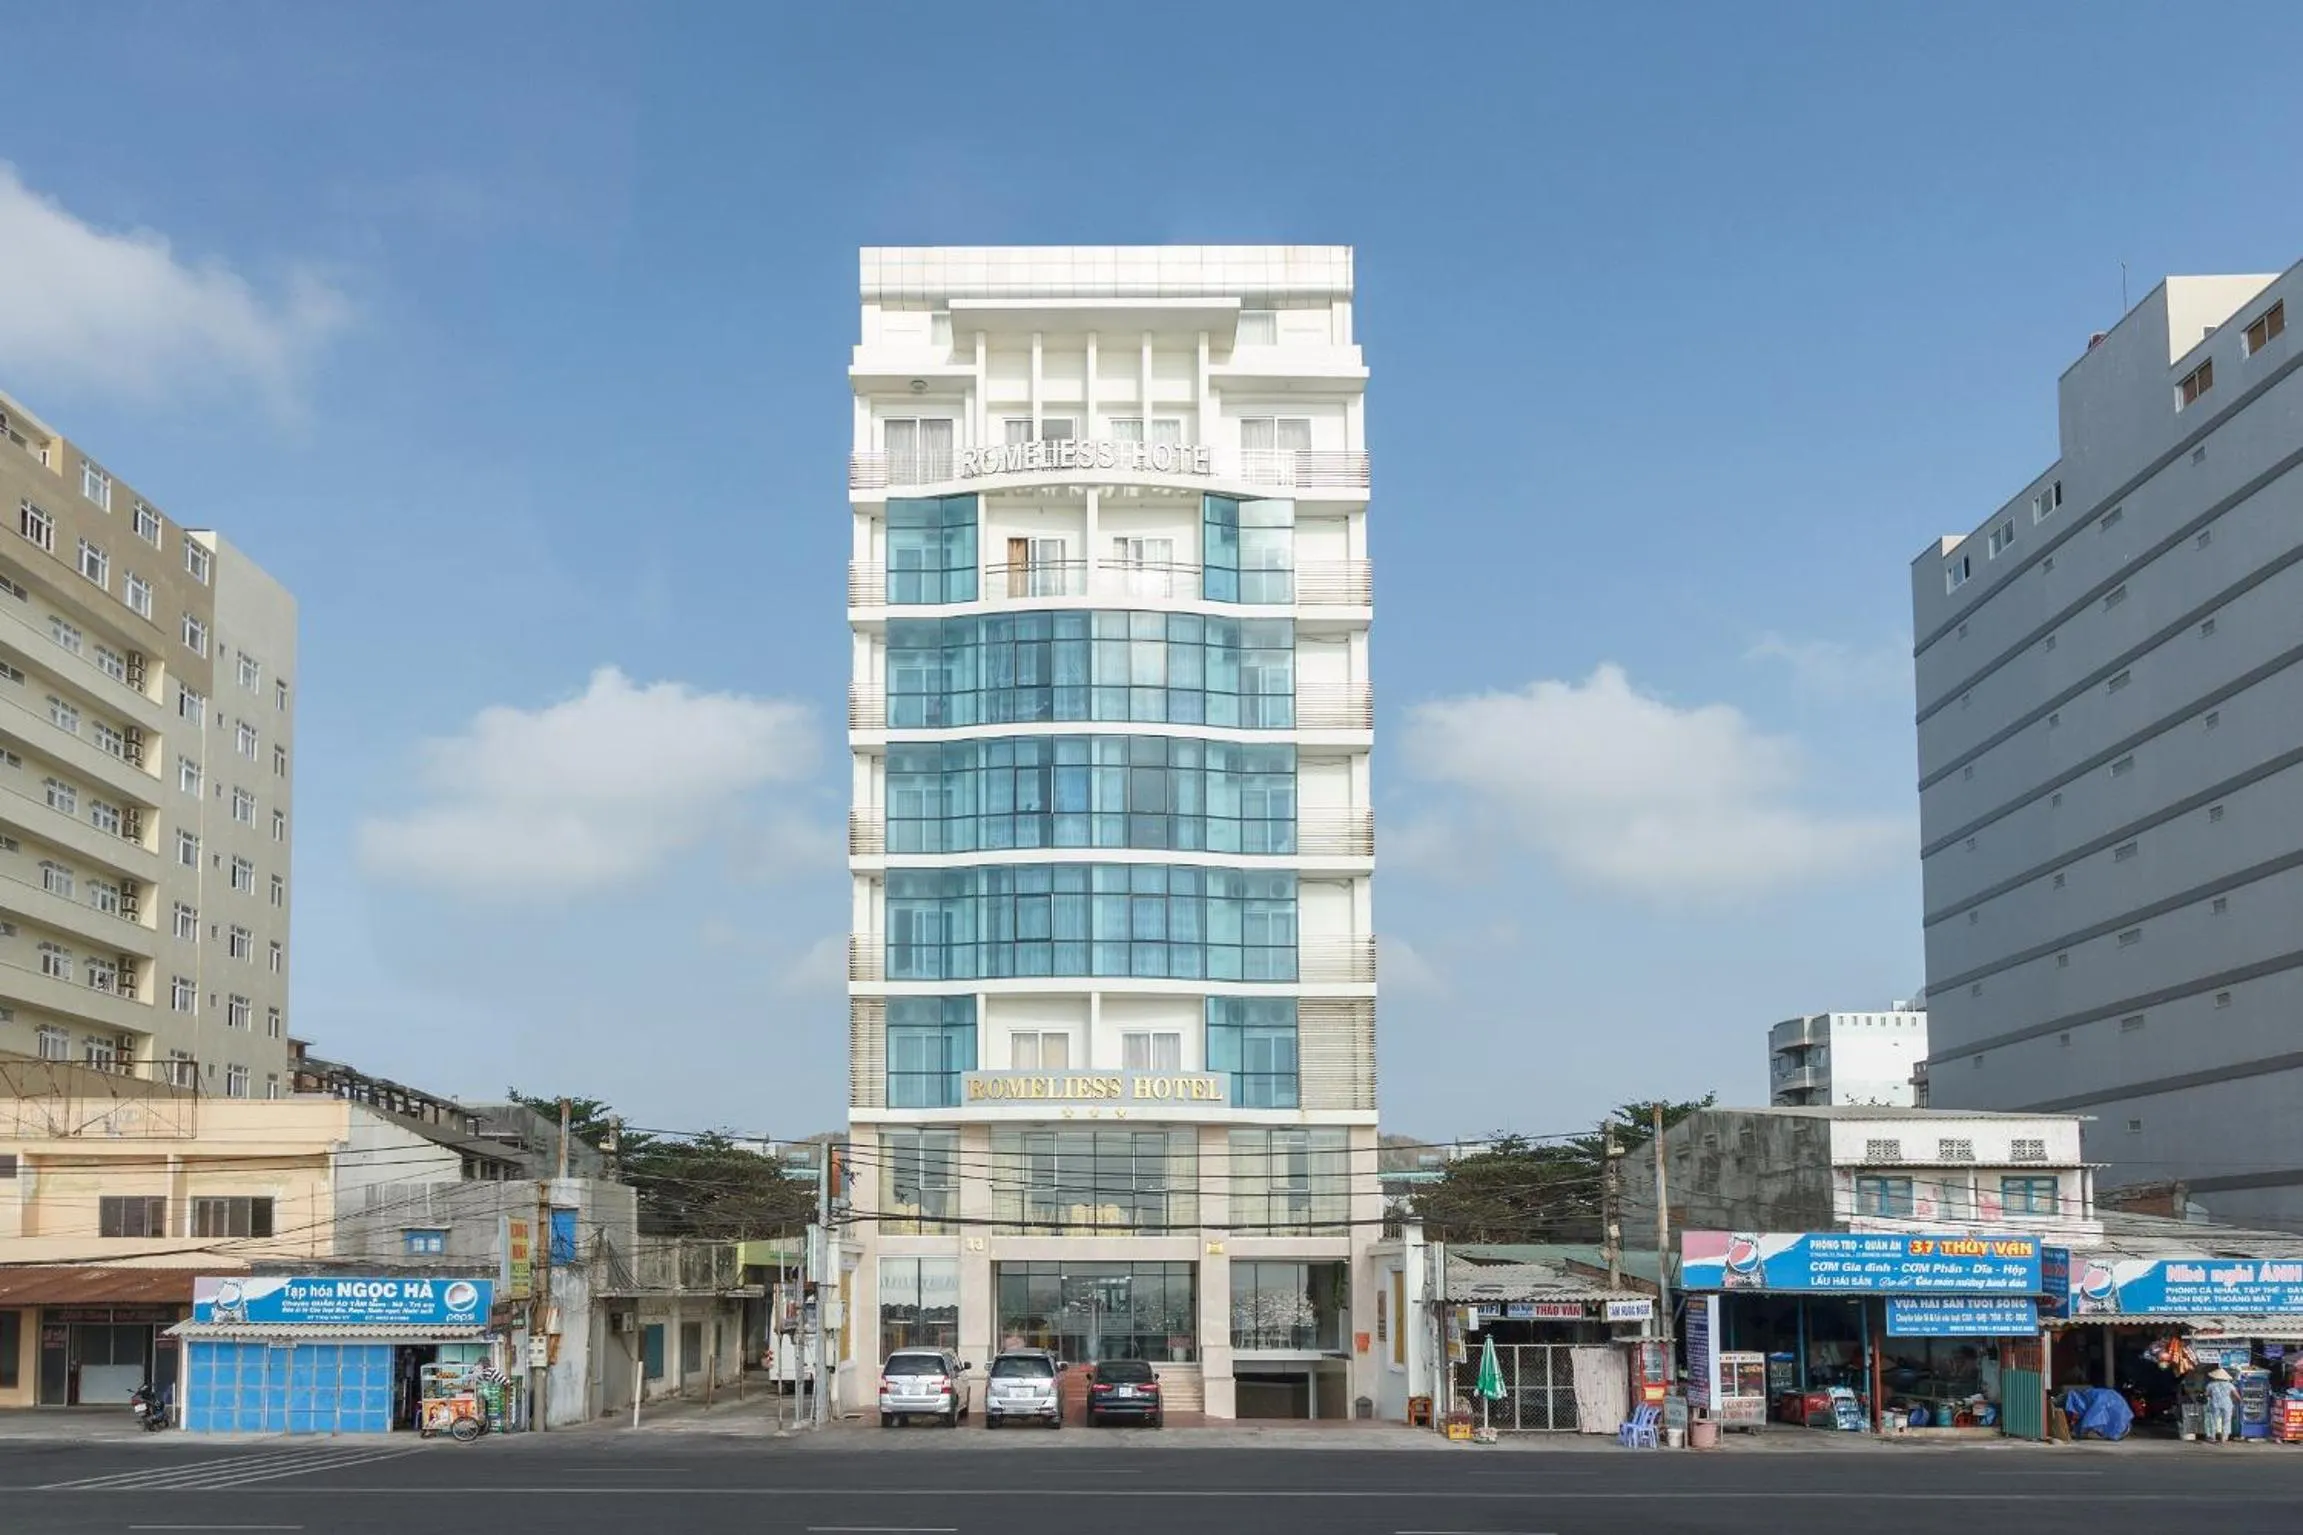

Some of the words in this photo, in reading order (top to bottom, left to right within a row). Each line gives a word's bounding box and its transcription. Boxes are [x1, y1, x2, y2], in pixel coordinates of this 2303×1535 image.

[962, 438, 1116, 478] ROMELIESS
[968, 1077, 1122, 1100] ROMELIESS
[1132, 1077, 1224, 1100] HOTEL
[1910, 1241, 1934, 1255] 37
[1842, 1262, 1861, 1272] Gia
[284, 1284, 307, 1300] Tạp
[309, 1284, 333, 1298] hóa
[336, 1282, 398, 1303] NGỌC
